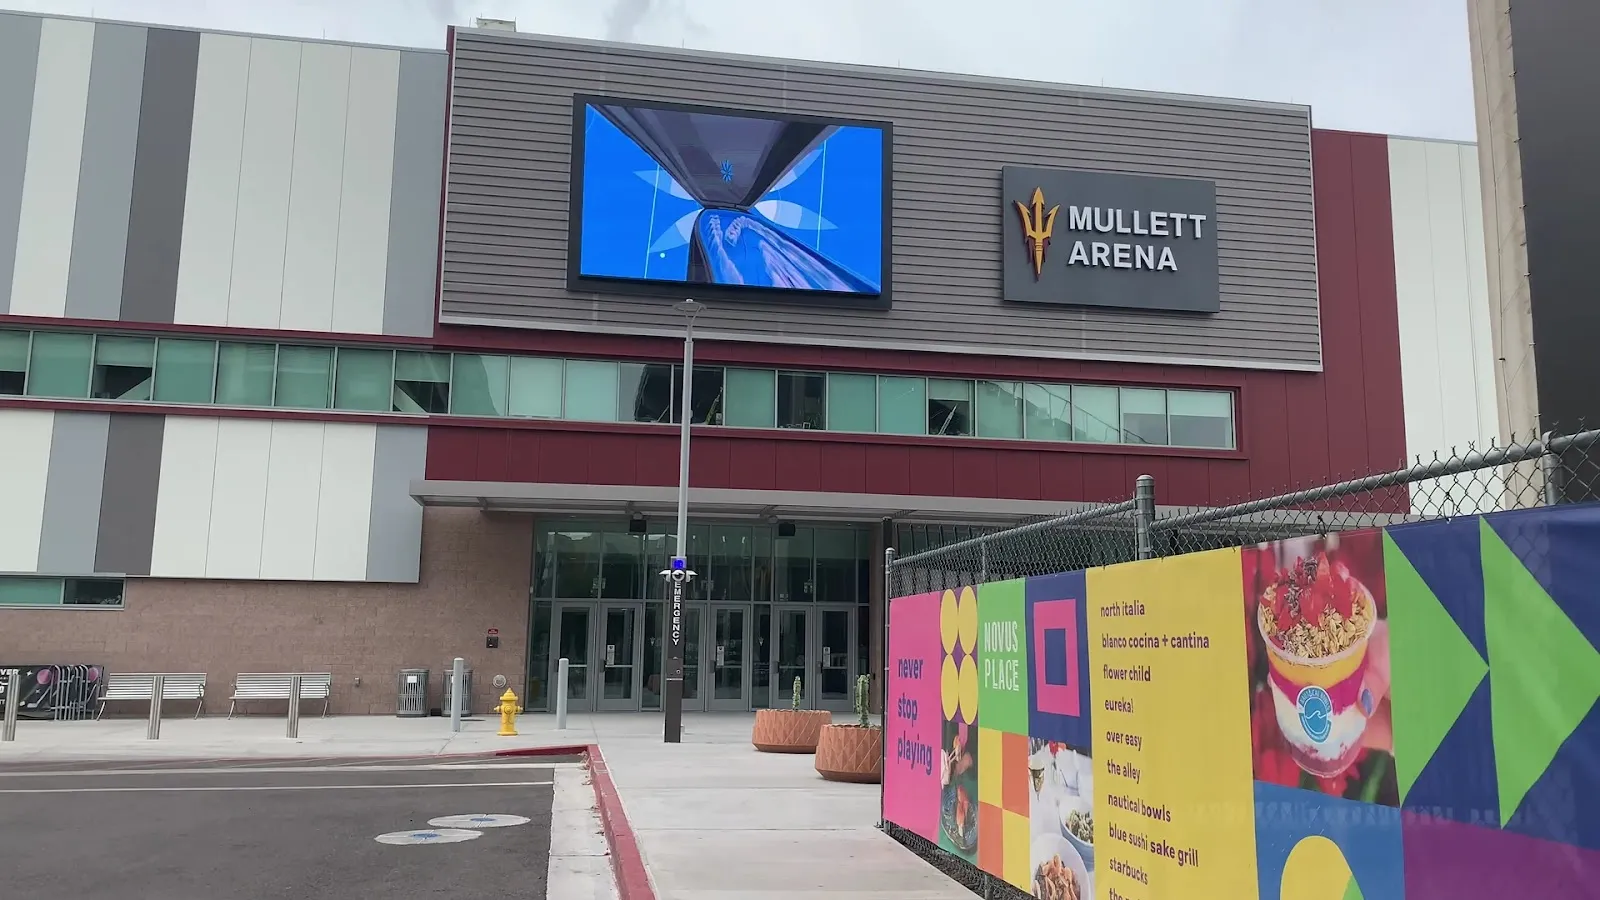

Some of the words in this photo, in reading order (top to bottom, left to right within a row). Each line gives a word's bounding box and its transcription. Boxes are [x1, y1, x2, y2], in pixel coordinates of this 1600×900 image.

[1069, 206, 1206, 238] MULLETT
[1068, 241, 1178, 271] ARENA
[672, 581, 682, 646] EMERGENCY
[1100, 602, 1120, 617] north
[1122, 600, 1145, 616] italia
[984, 621, 1018, 652] NOVUS
[1102, 633, 1127, 648] blanco
[1128, 632, 1159, 648] cocina
[1162, 634, 1169, 646] +
[1170, 631, 1210, 648] cantina
[898, 658, 923, 679] never
[984, 659, 1019, 691] PLACE
[1103, 664, 1127, 680] flower
[1129, 665, 1151, 681] child
[897, 692, 918, 727] stop
[1104, 697, 1134, 713] eureka!
[897, 731, 932, 775] playing
[1106, 730, 1124, 744] over
[1125, 733, 1142, 751] easy
[1107, 759, 1121, 775] the
[1122, 762, 1141, 784] alley
[1108, 794, 1140, 814] nautical
[1141, 800, 1171, 822] bowls
[1109, 822, 1127, 842] blue
[1128, 832, 1148, 851] sushi
[1150, 839, 1175, 859] sake
[1177, 848, 1199, 867] grill
[1109, 857, 1148, 885] starbucks
